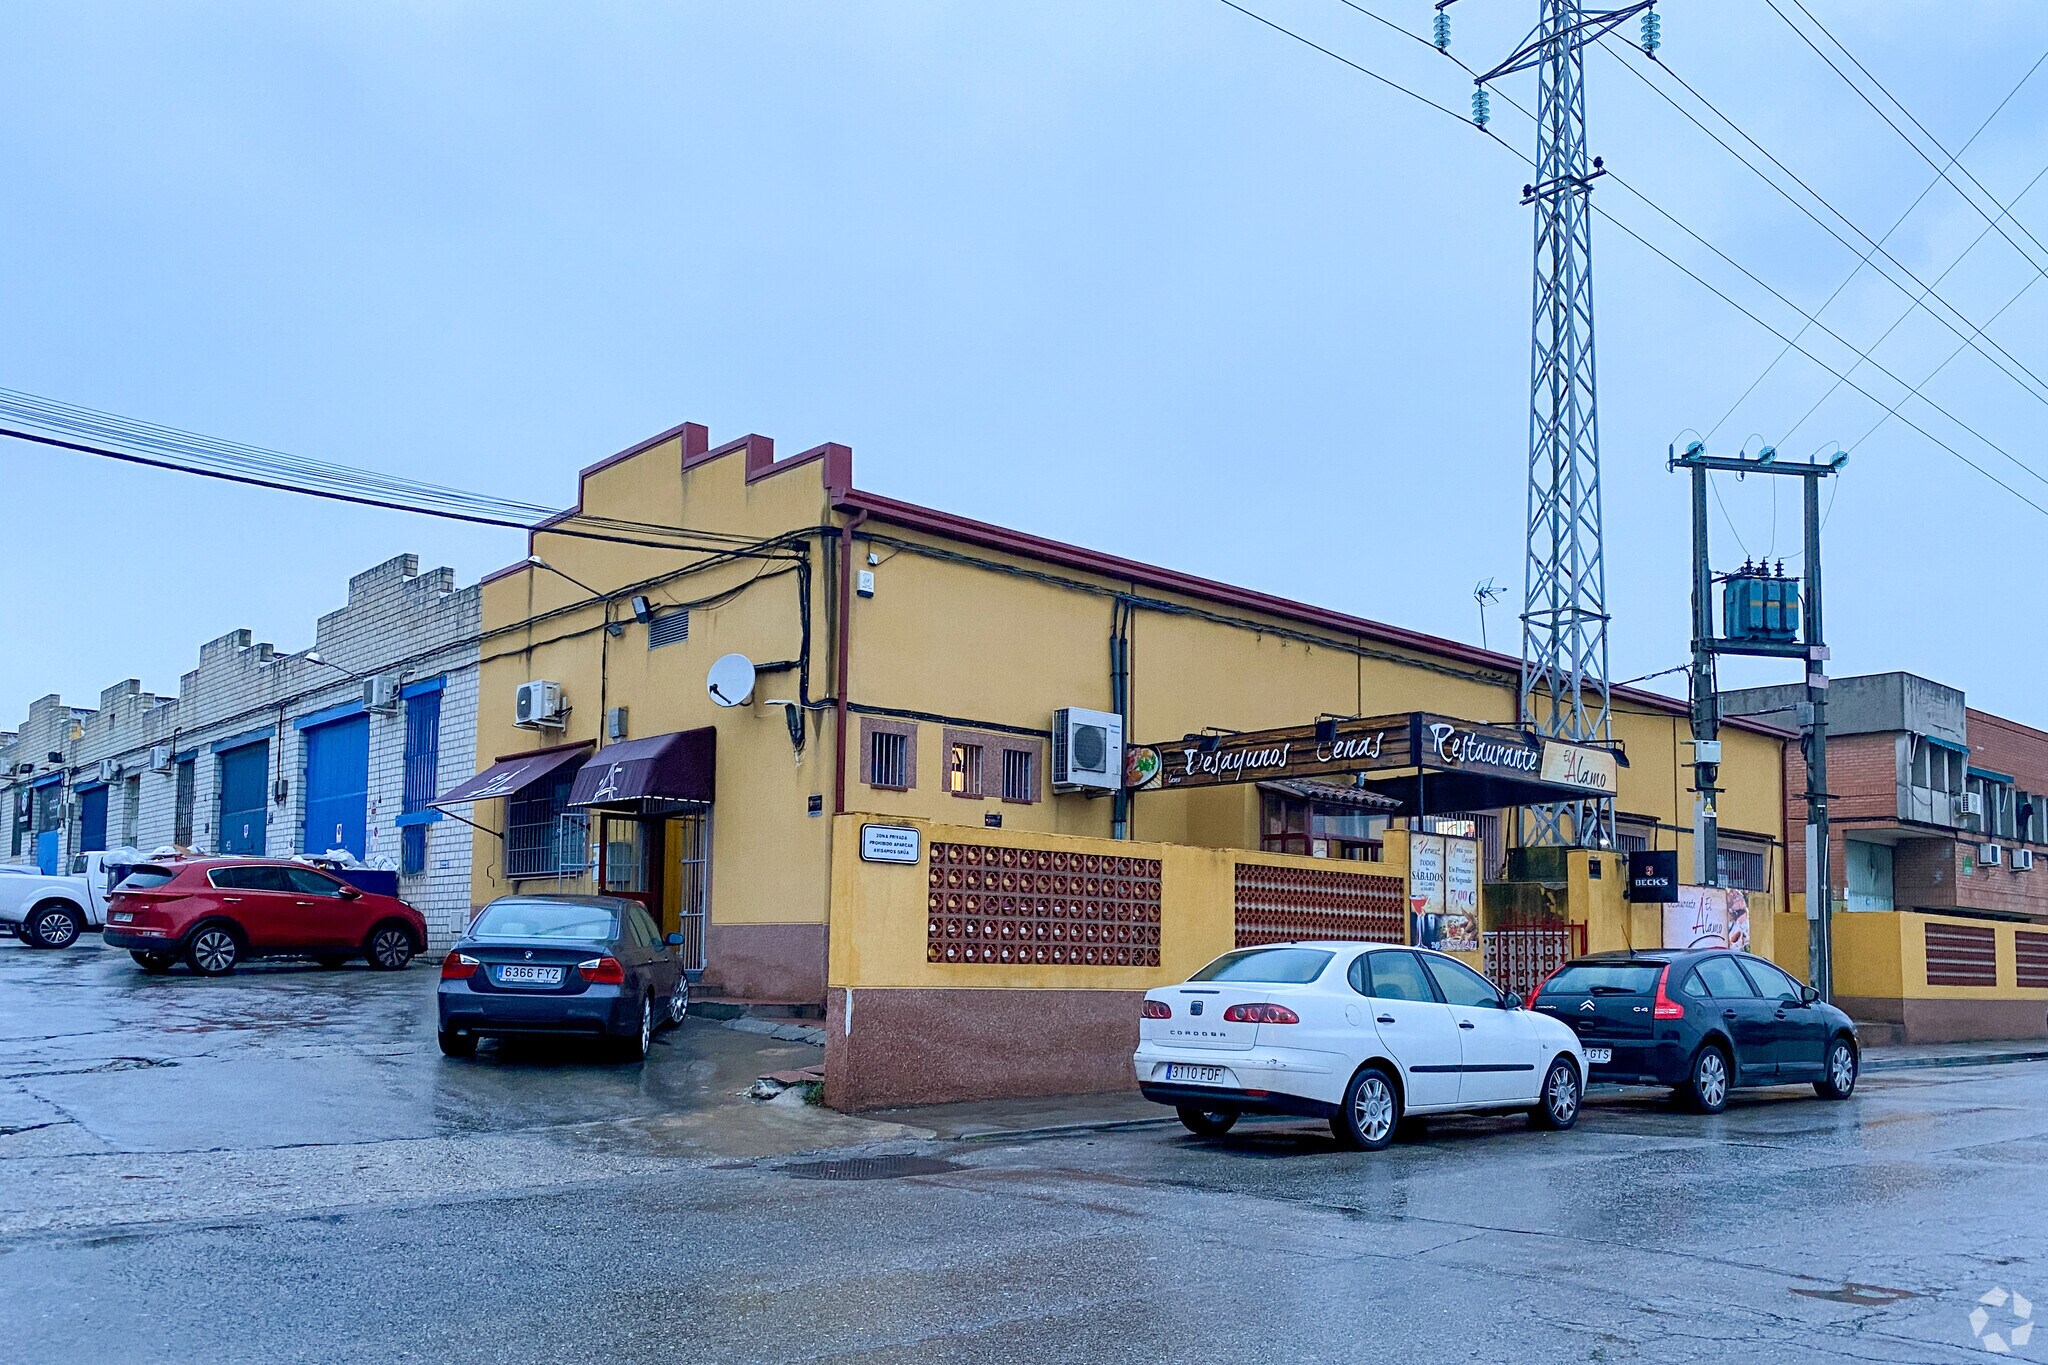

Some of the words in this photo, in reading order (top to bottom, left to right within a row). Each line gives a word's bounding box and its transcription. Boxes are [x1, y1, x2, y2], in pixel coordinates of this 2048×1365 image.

[1430, 723, 1537, 771] Restaurante
[1184, 742, 1291, 782] Desayunos
[1316, 731, 1384, 763] Cenas
[1420, 859, 1436, 867] TODOS
[1411, 869, 1444, 882] SÁBADOS
[1456, 866, 1472, 874] Primero
[1456, 876, 1473, 885] Segundo
[1635, 877, 1669, 886] BECK'S
[505, 966, 534, 978] 6366
[537, 968, 559, 980] FYZ
[1590, 1048, 1610, 1060] GTS
[1172, 1066, 1198, 1080] 3110
[1200, 1067, 1222, 1081] FDF
